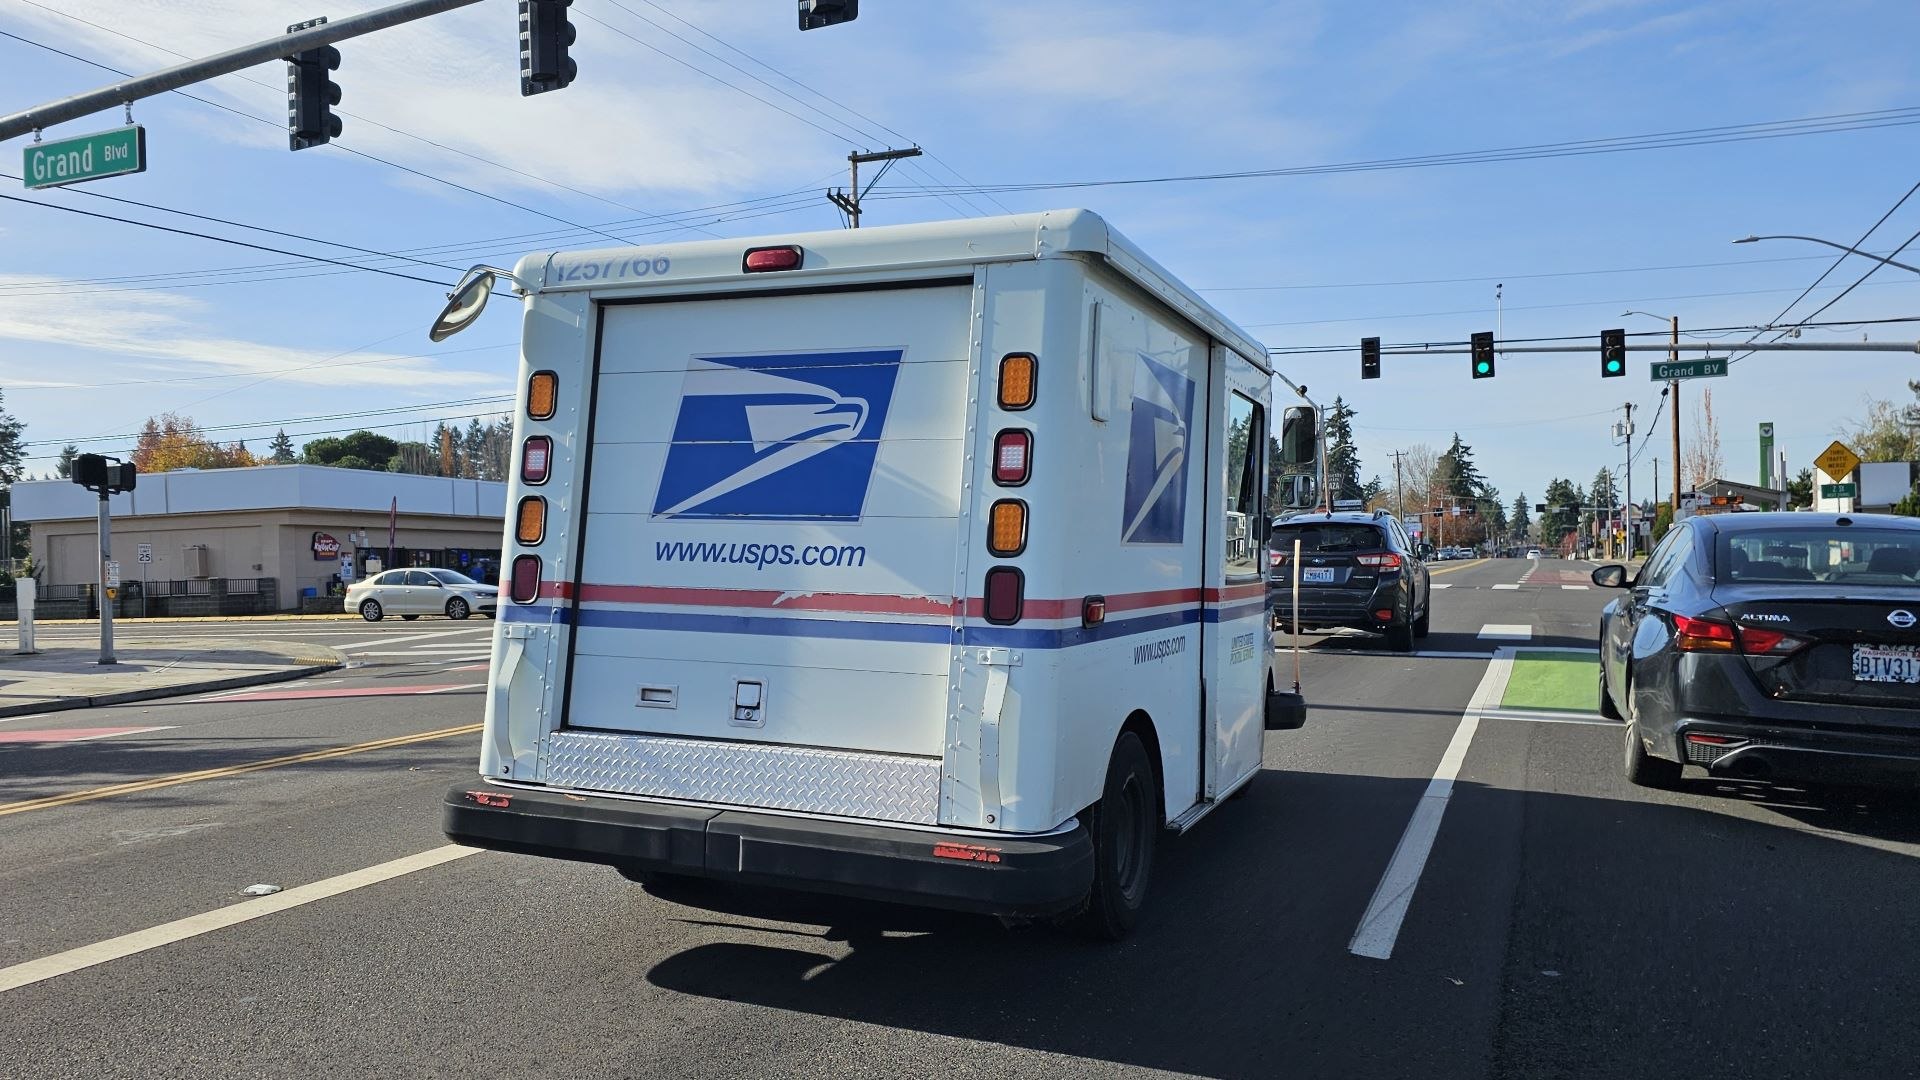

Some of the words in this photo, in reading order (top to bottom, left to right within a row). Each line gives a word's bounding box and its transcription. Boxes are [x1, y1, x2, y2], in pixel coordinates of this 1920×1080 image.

[33, 142, 92, 180] Grand
[104, 143, 128, 161] Blvd
[557, 256, 671, 281] 1257766
[1659, 365, 1694, 377] Grand
[1704, 364, 1719, 374] BV
[139, 553, 151, 561] 25
[656, 541, 866, 570] www.usps.com
[1740, 613, 1791, 622] ALTIMA
[1133, 636, 1186, 665] www.usps.com
[1861, 649, 1908, 657] WASHINGTON
